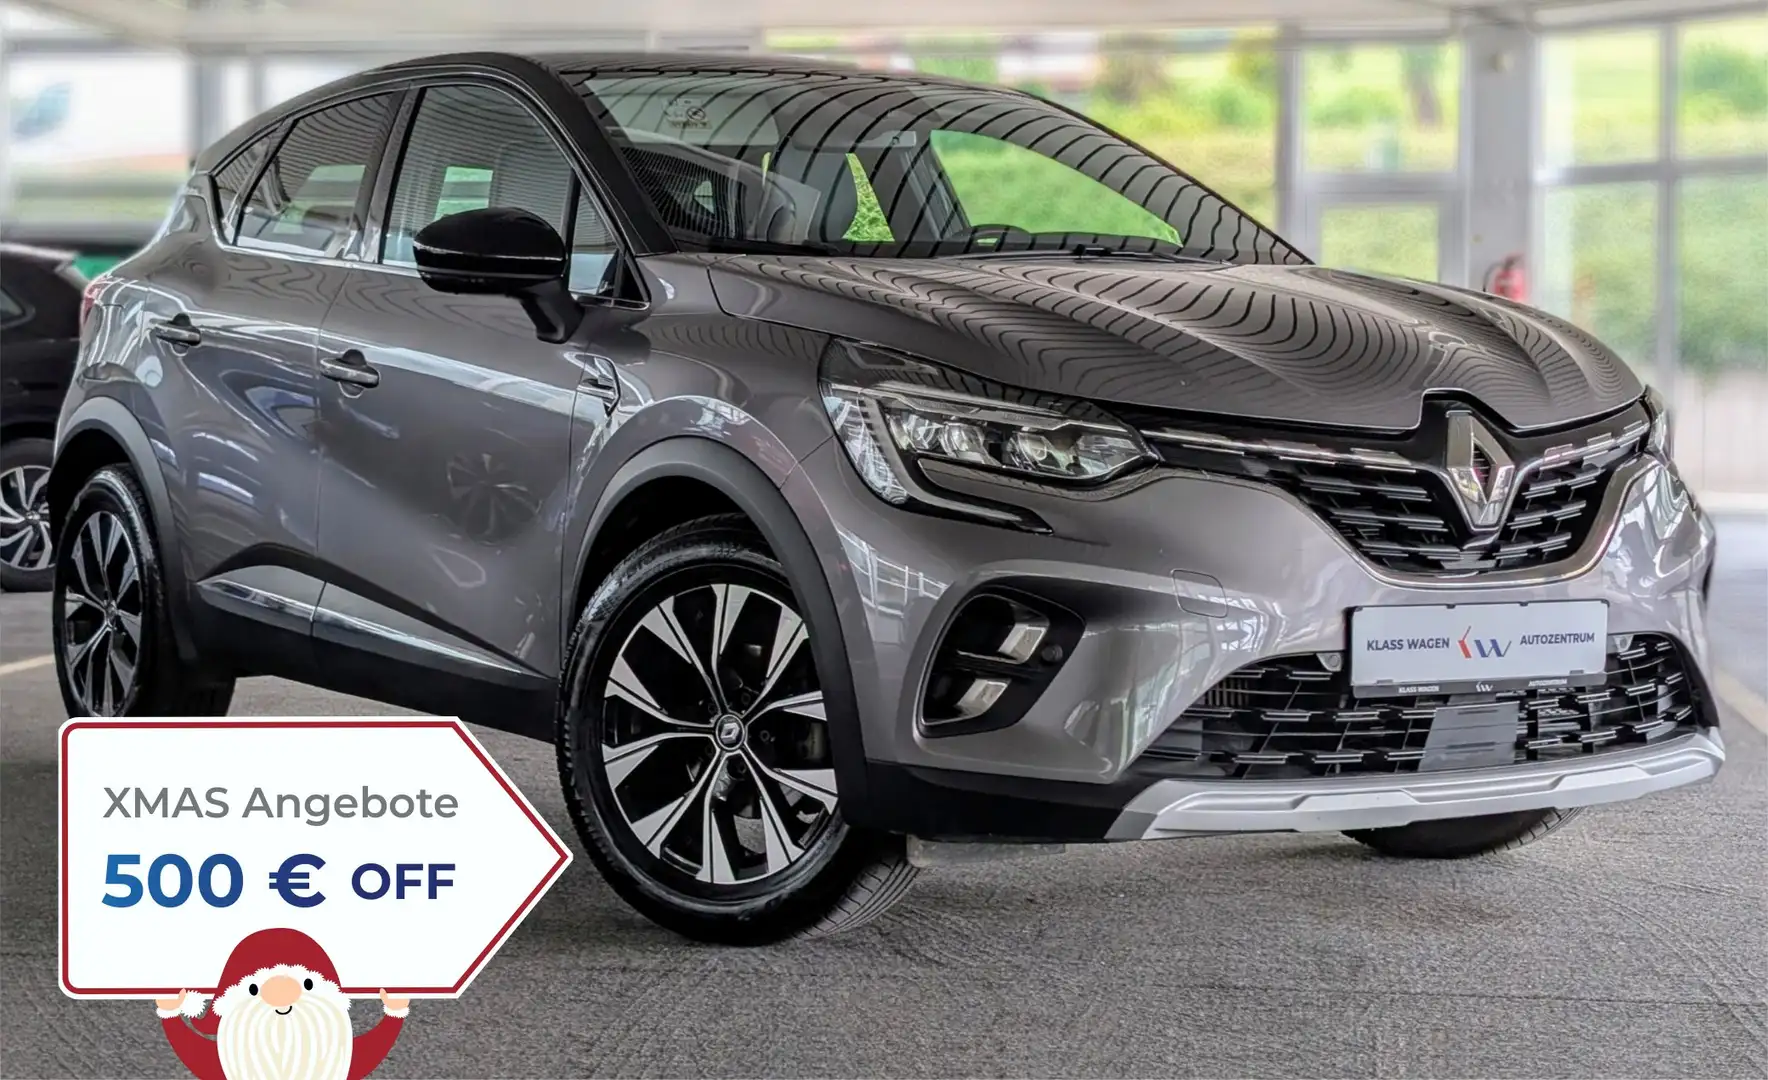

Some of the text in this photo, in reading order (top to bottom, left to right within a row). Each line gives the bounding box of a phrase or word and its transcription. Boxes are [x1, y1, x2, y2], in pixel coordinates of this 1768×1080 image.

[1366, 639, 1404, 651] KLASS
[1406, 637, 1450, 650] WAGEN
[1519, 632, 1595, 646] AUTOZENTRUM
